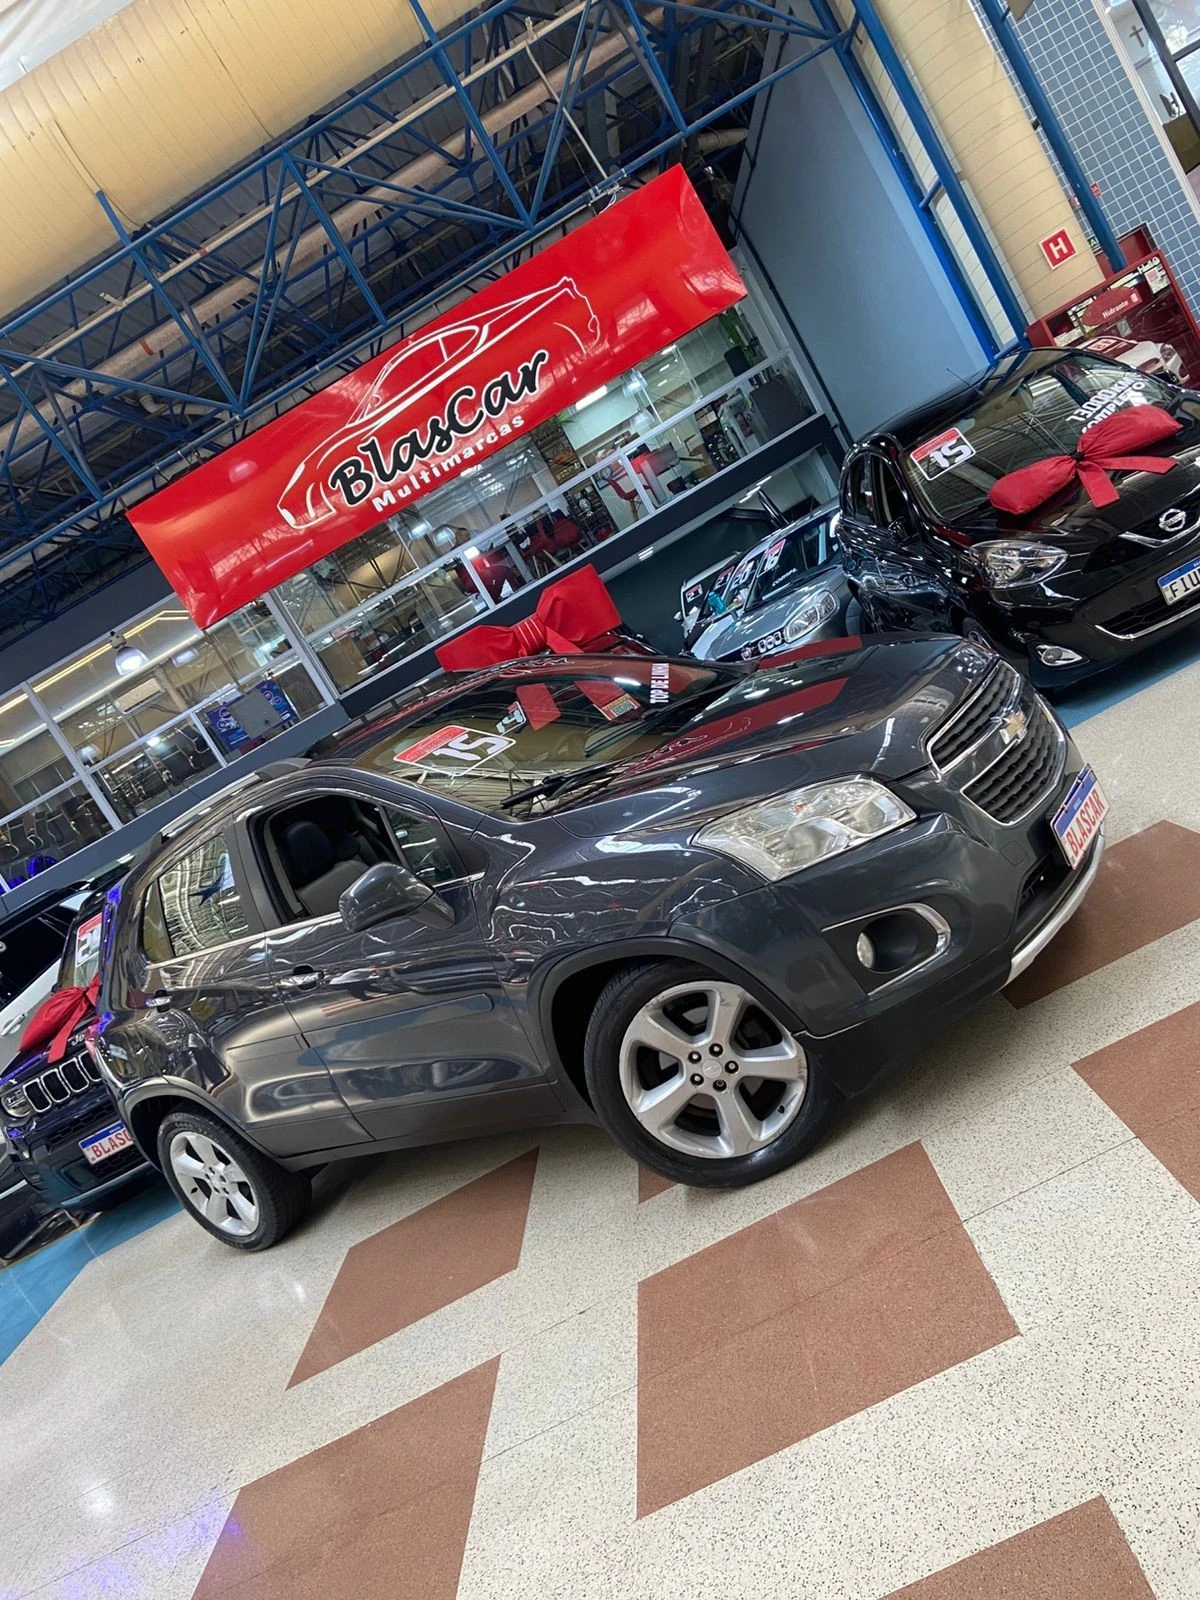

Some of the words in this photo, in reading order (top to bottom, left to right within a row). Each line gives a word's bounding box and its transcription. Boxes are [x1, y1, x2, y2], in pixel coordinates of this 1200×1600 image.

[1048, 237, 1069, 260] H
[1102, 300, 1130, 319] Hidrante
[330, 350, 549, 506] BlasCar
[372, 414, 526, 513] Multimarcas
[929, 439, 972, 468] 15
[649, 689, 669, 703] TOP
[650, 680, 669, 689] DE
[432, 733, 510, 761] 15
[1065, 788, 1106, 858] BLASCAR
